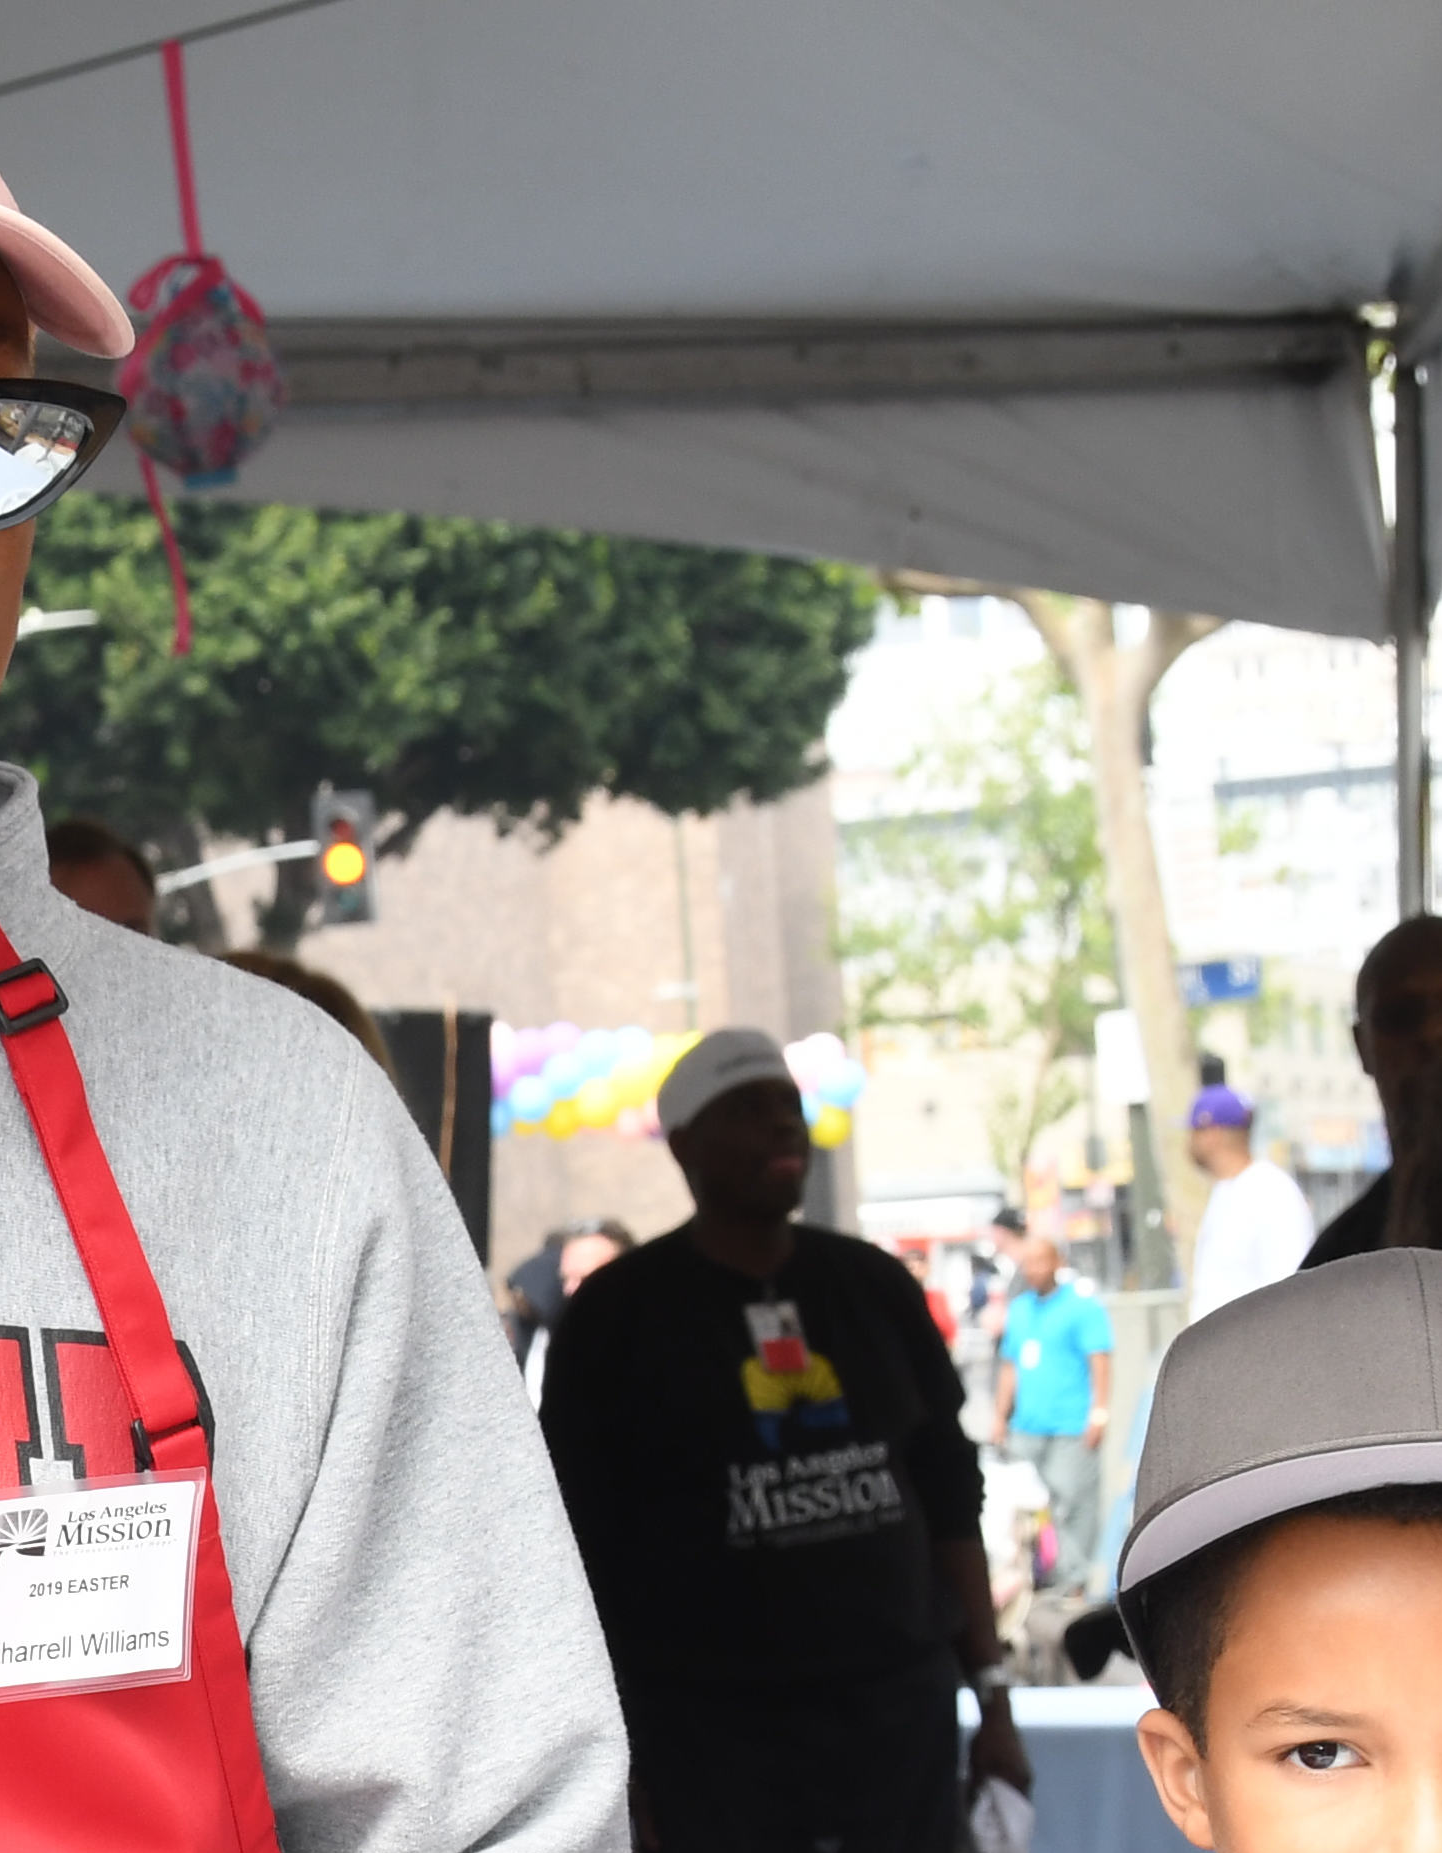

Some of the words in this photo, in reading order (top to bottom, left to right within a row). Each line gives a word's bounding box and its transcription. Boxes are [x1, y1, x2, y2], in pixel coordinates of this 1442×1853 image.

[67, 1510, 96, 1524] Los
[99, 1501, 168, 1521] Angeles
[29, 1581, 63, 1598] 2019
[68, 1574, 130, 1594] EASTER
[80, 1630, 170, 1657] Williams
